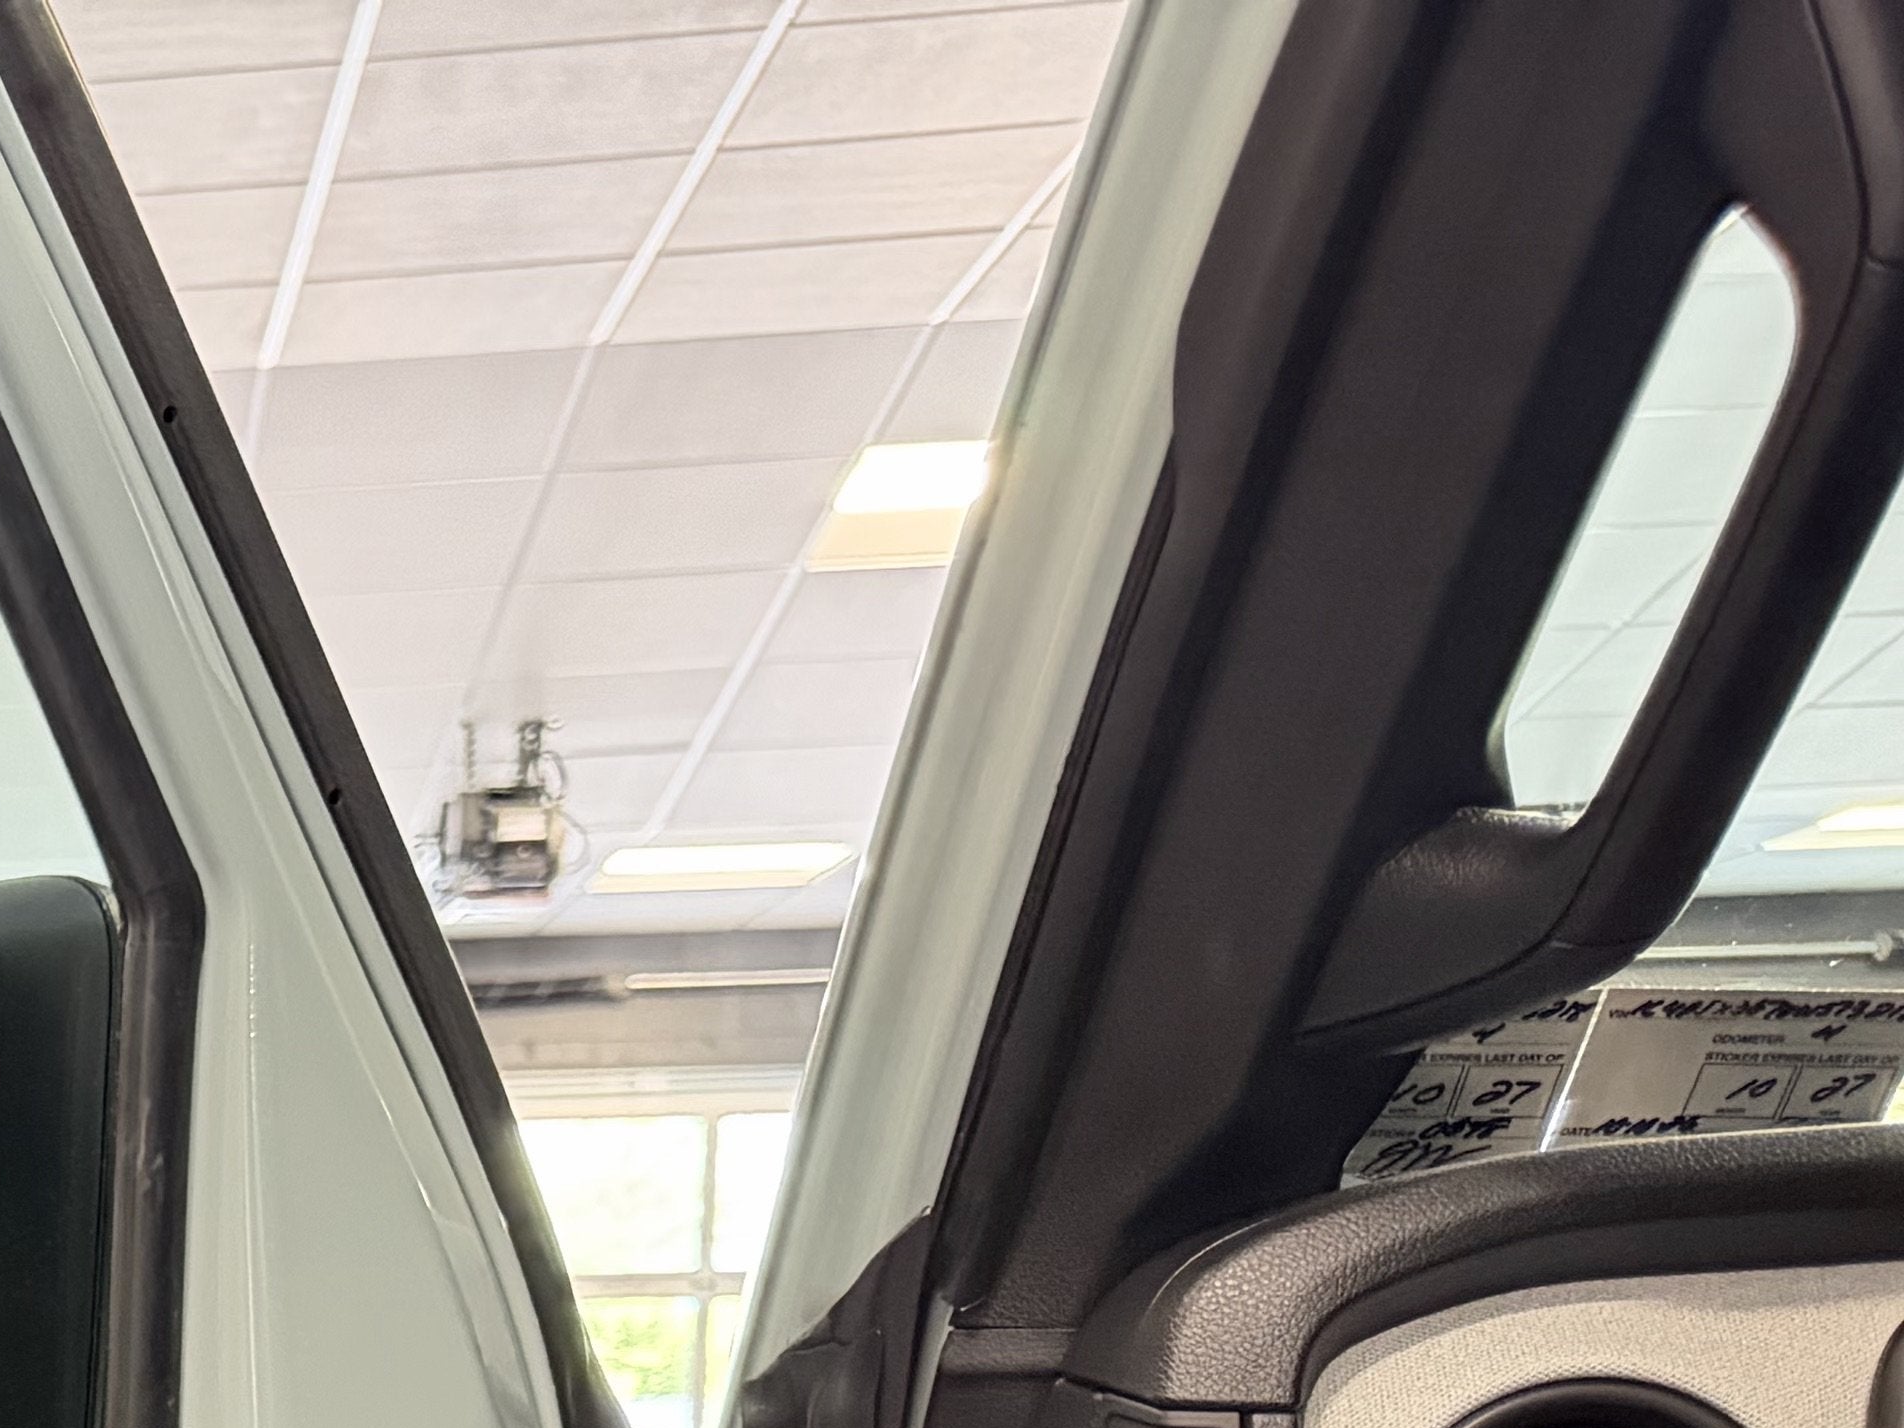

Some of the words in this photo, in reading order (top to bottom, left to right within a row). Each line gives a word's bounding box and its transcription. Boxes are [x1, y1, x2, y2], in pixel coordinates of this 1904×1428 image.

[1711, 1034, 1786, 1045] ODOMETER
[1484, 1053, 1516, 1064] LAST
[1518, 1053, 1542, 1064] DAY
[1544, 1053, 1566, 1064] OF
[1703, 1052, 1760, 1063] STICKER
[1818, 1054, 1849, 1065] LAST
[1472, 1080, 1542, 1107] 27
[1724, 1077, 1778, 1100] 10
[1810, 1072, 1877, 1103] 27
[1559, 1127, 1593, 1137] DATE
